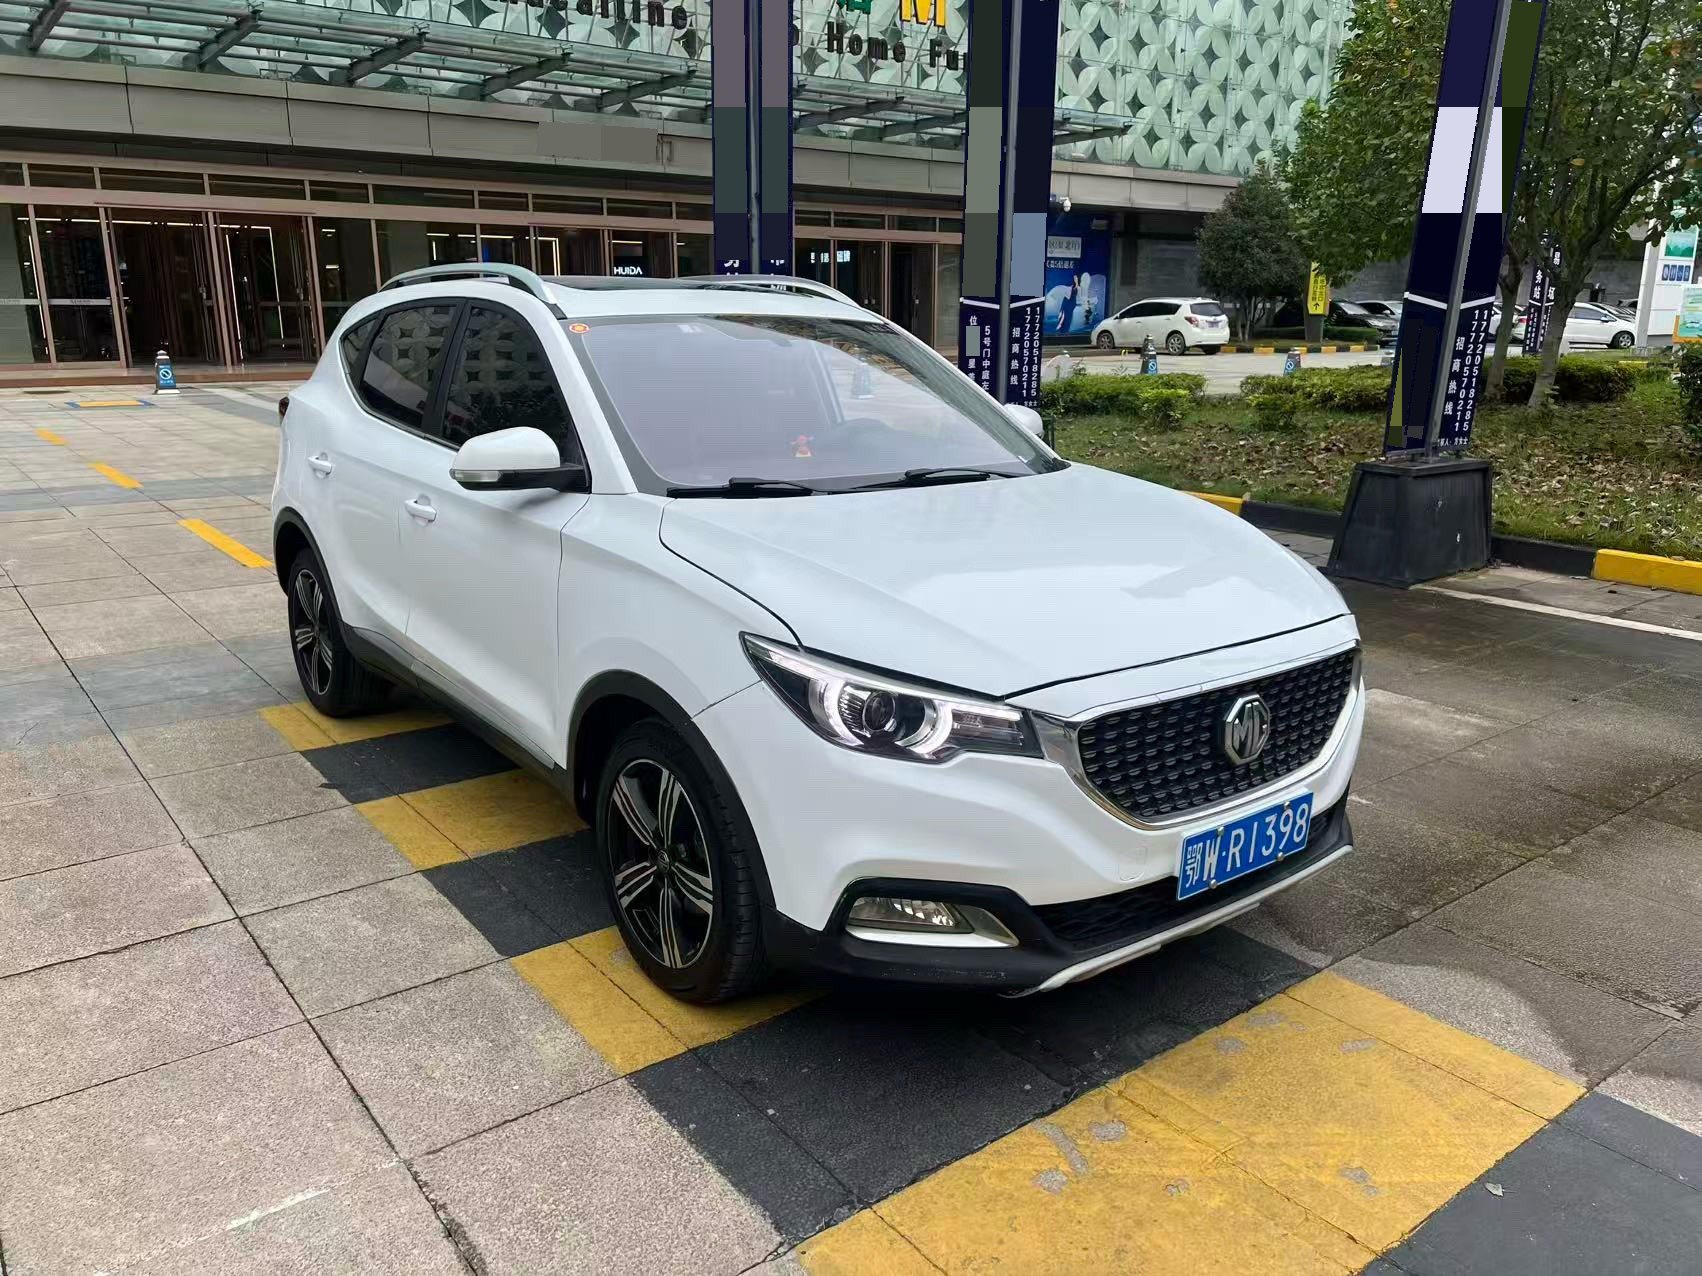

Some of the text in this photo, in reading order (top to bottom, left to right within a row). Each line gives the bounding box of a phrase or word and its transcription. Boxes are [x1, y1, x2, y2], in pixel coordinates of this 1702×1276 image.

[827, 21, 906, 63] Home
[613, 266, 643, 276] HUIDA
[1010, 327, 1020, 385] 招商热线
[1022, 307, 1031, 397] 17720570211
[1031, 307, 1040, 397] 17720518285
[1444, 336, 1466, 416] 招商热线
[1454, 310, 1479, 431] 17720570211
[1463, 310, 1488, 431] 17720518285
[1232, 701, 1268, 757] MG
[1185, 803, 1309, 888] 鄂W·R1398
